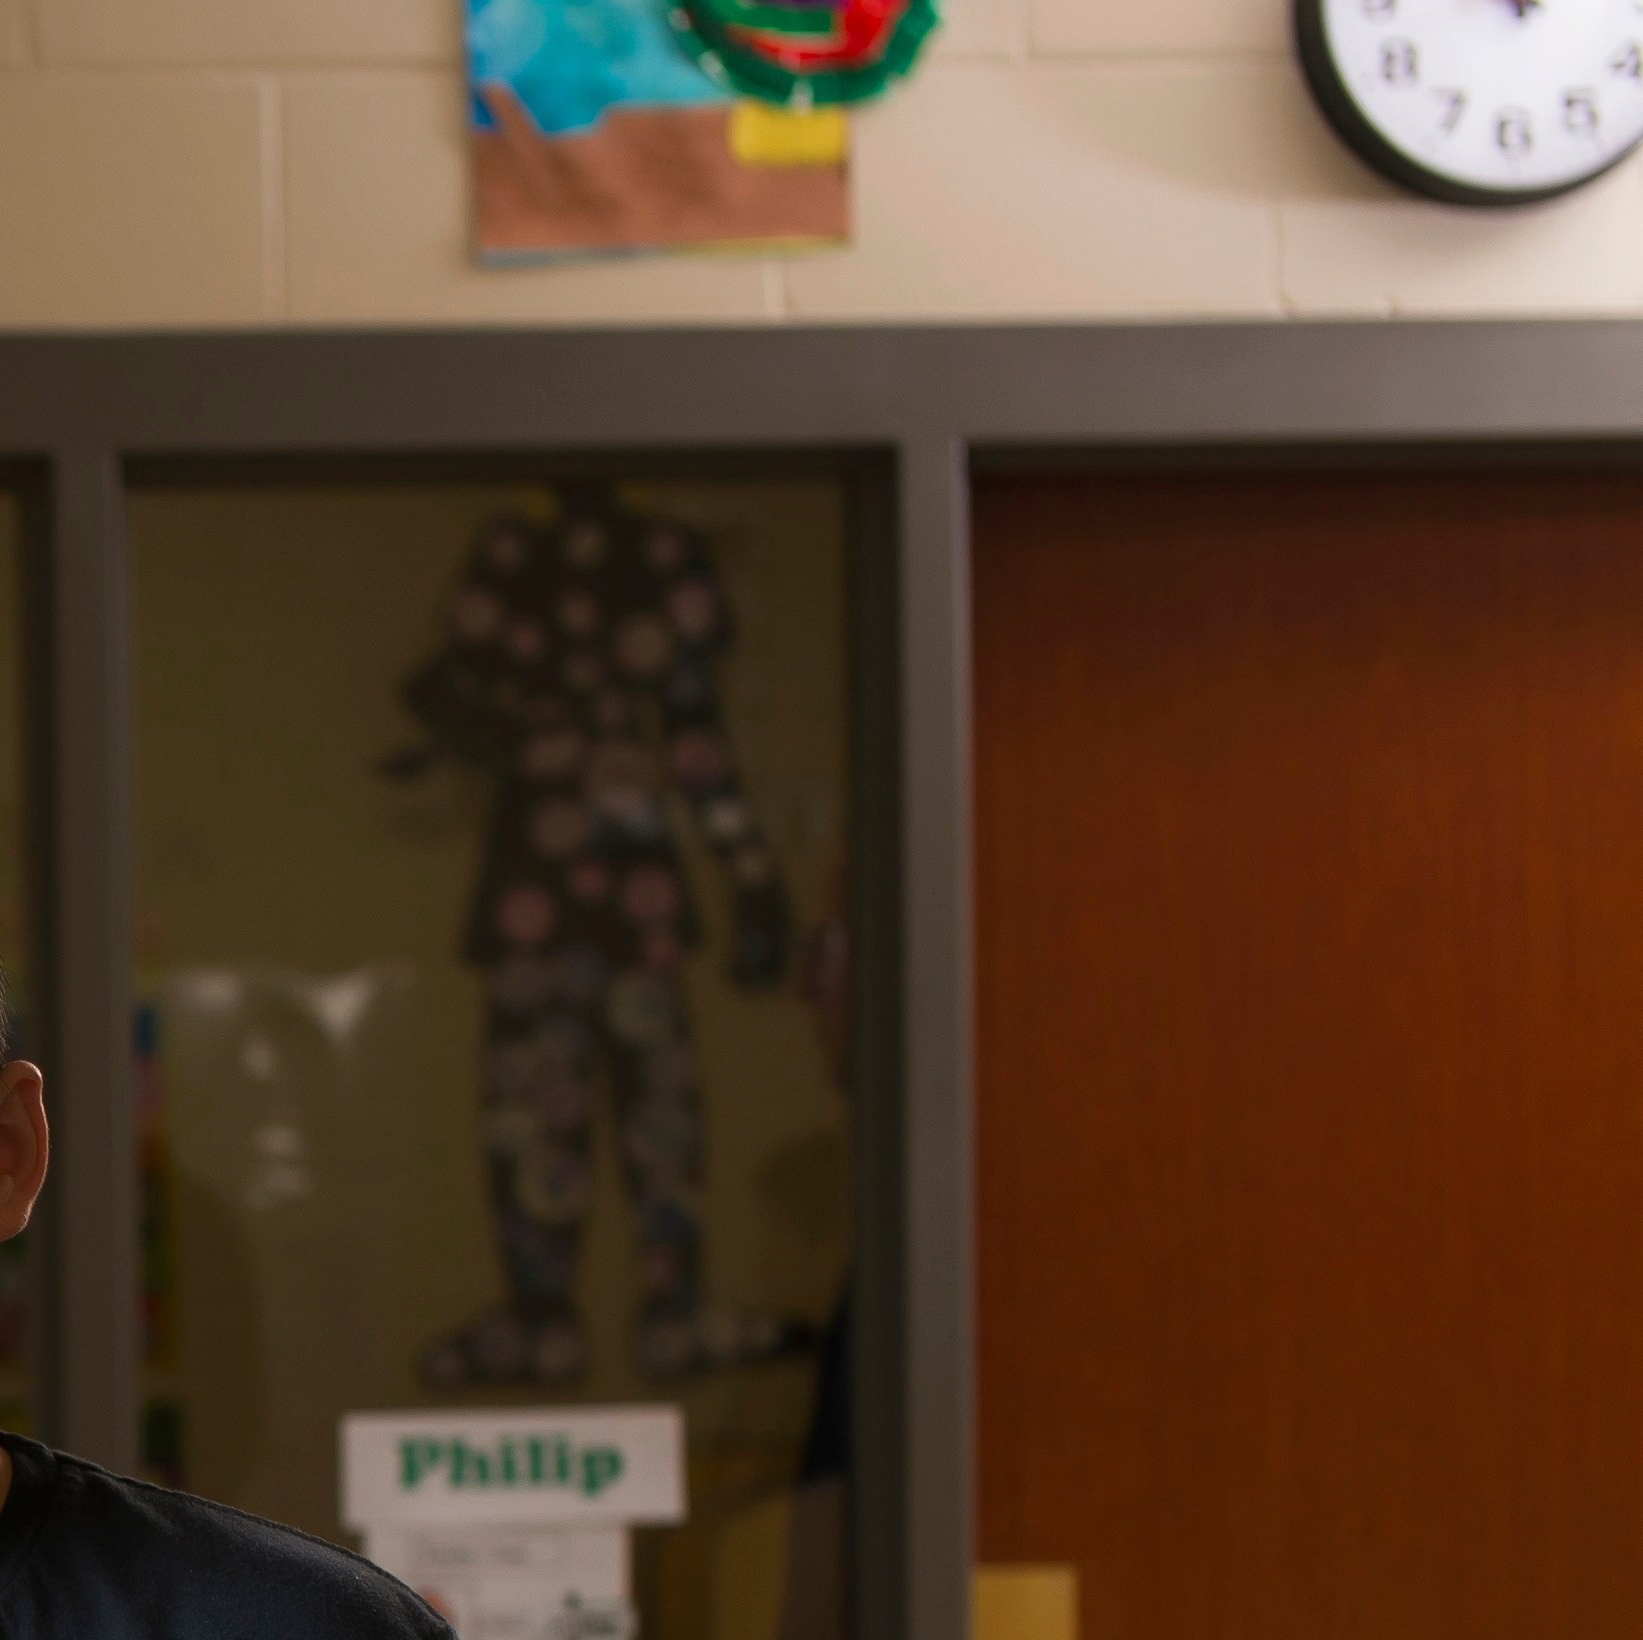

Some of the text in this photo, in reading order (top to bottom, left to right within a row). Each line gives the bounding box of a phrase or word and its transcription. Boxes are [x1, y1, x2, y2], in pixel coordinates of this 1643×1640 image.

[1432, 86, 1466, 136] 7
[1497, 107, 1531, 158] 6
[396, 1433, 626, 1498] Philip
